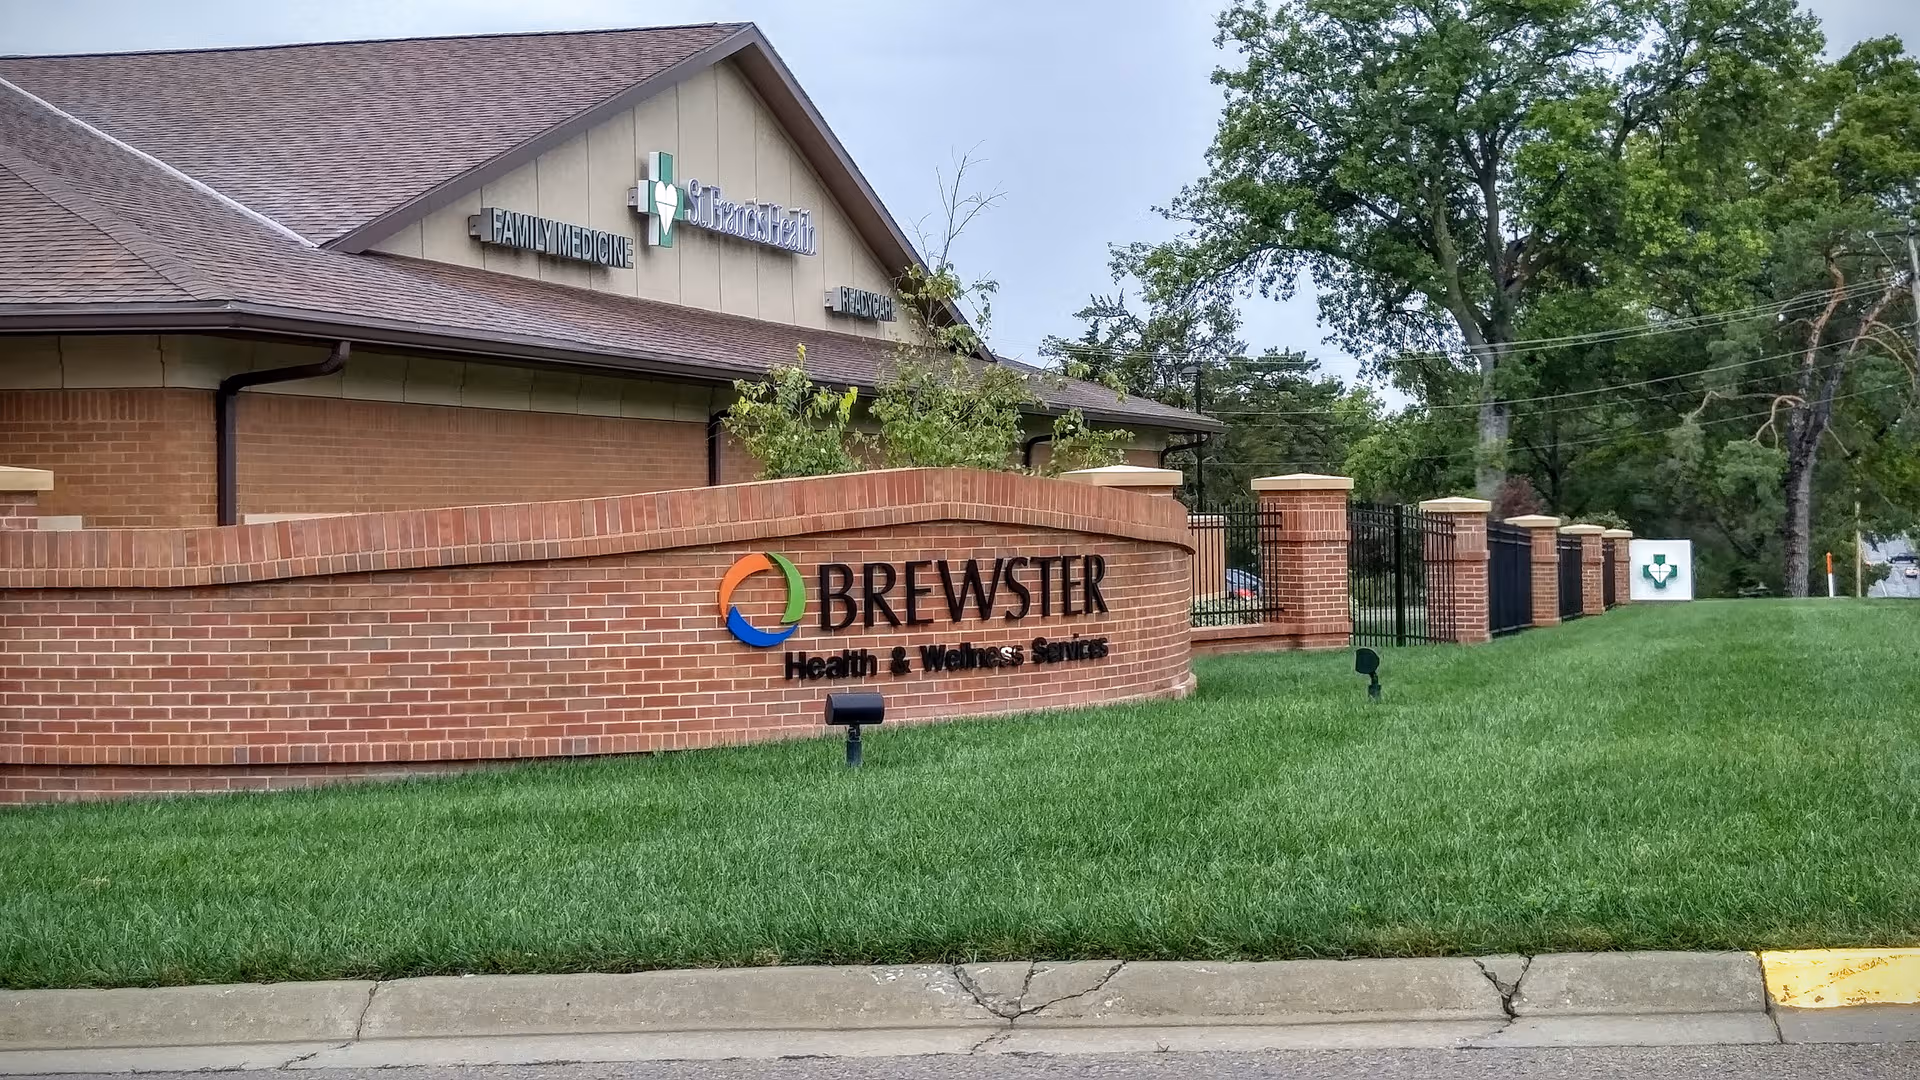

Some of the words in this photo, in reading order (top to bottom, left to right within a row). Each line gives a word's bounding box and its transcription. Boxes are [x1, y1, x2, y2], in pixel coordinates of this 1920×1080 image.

[492, 207, 553, 252] FAMILY
[555, 221, 634, 269] MEDICINE
[708, 185, 767, 243] Francis
[766, 202, 817, 257] Health
[819, 554, 1110, 632] BREWSTER
[785, 649, 878, 681] Health
[890, 646, 912, 677] &
[919, 642, 1025, 673] Wellness
[1031, 633, 1110, 664] Services
